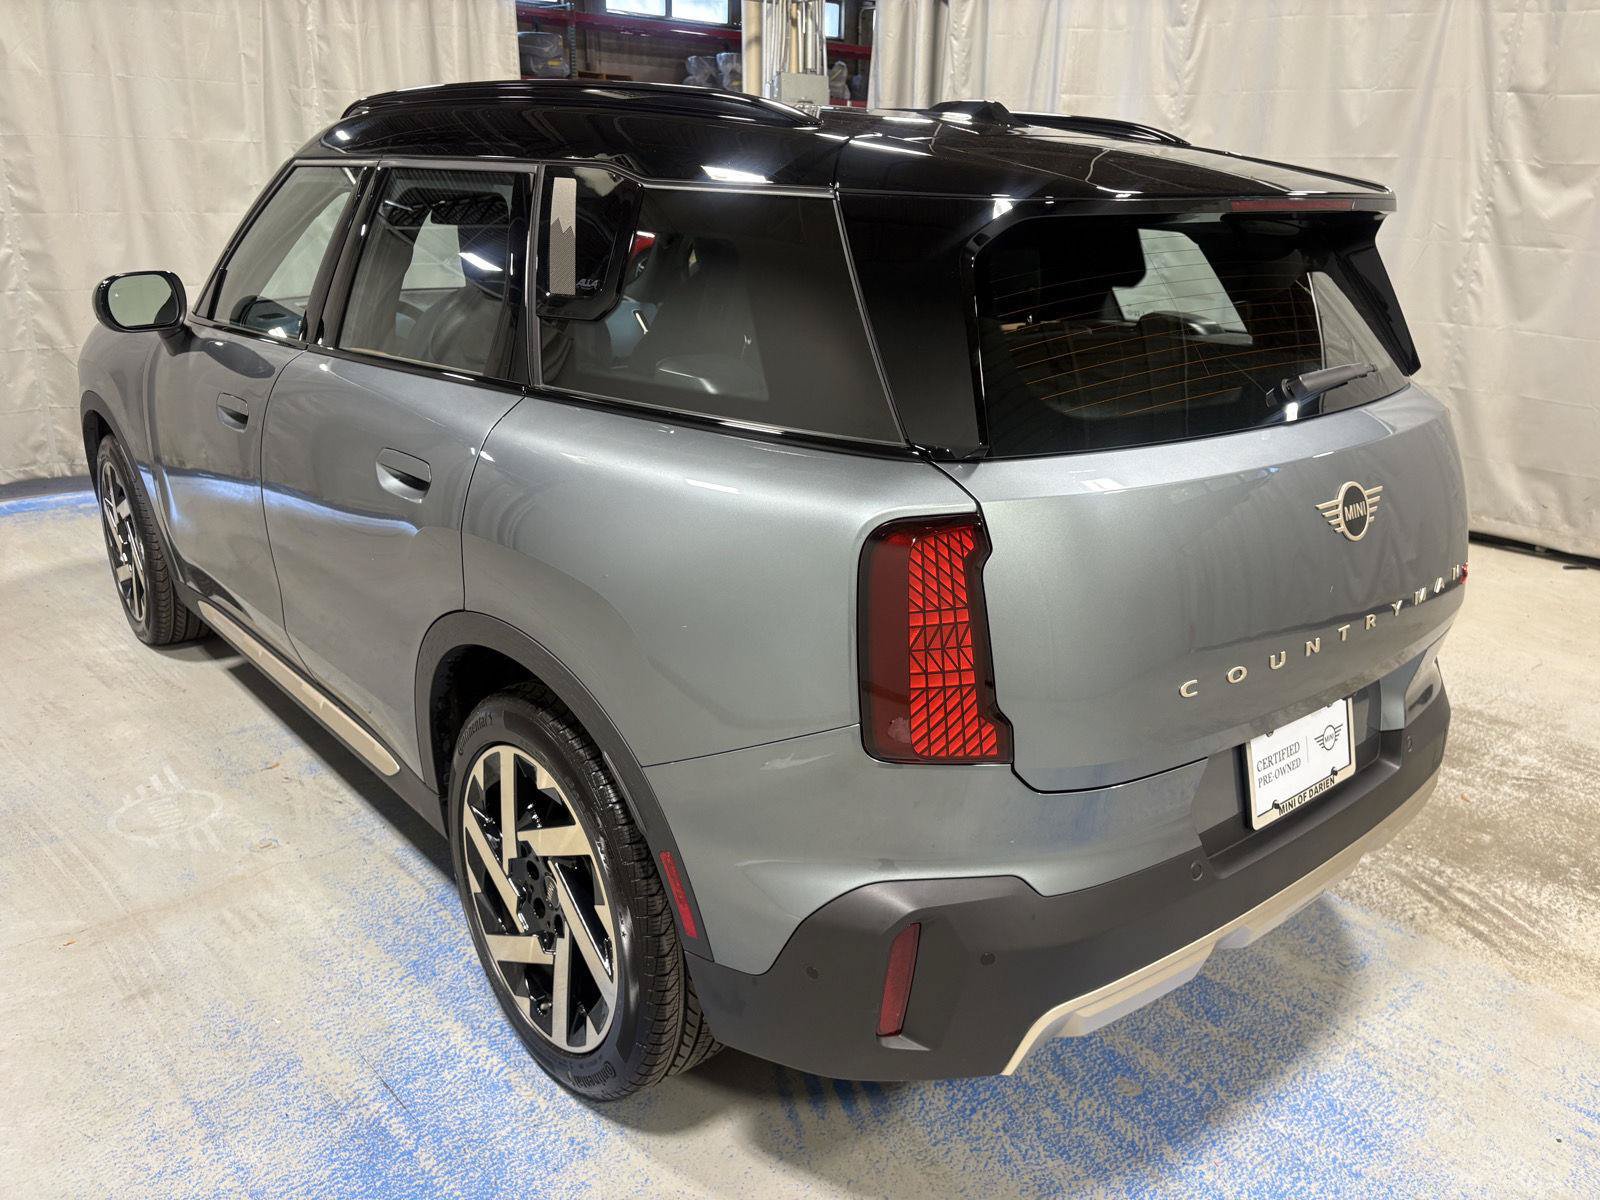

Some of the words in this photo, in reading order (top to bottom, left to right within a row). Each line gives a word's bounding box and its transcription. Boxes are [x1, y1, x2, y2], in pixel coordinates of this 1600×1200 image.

[1344, 501, 1367, 522] MINI
[1324, 734, 1335, 743] MINI
[1256, 741, 1300, 773] CERTIFIED
[1258, 757, 1301, 788] PRE-OWNED
[1278, 799, 1296, 816] MINI
[1297, 792, 1307, 806] OF
[1308, 776, 1336, 799] DARIEN
